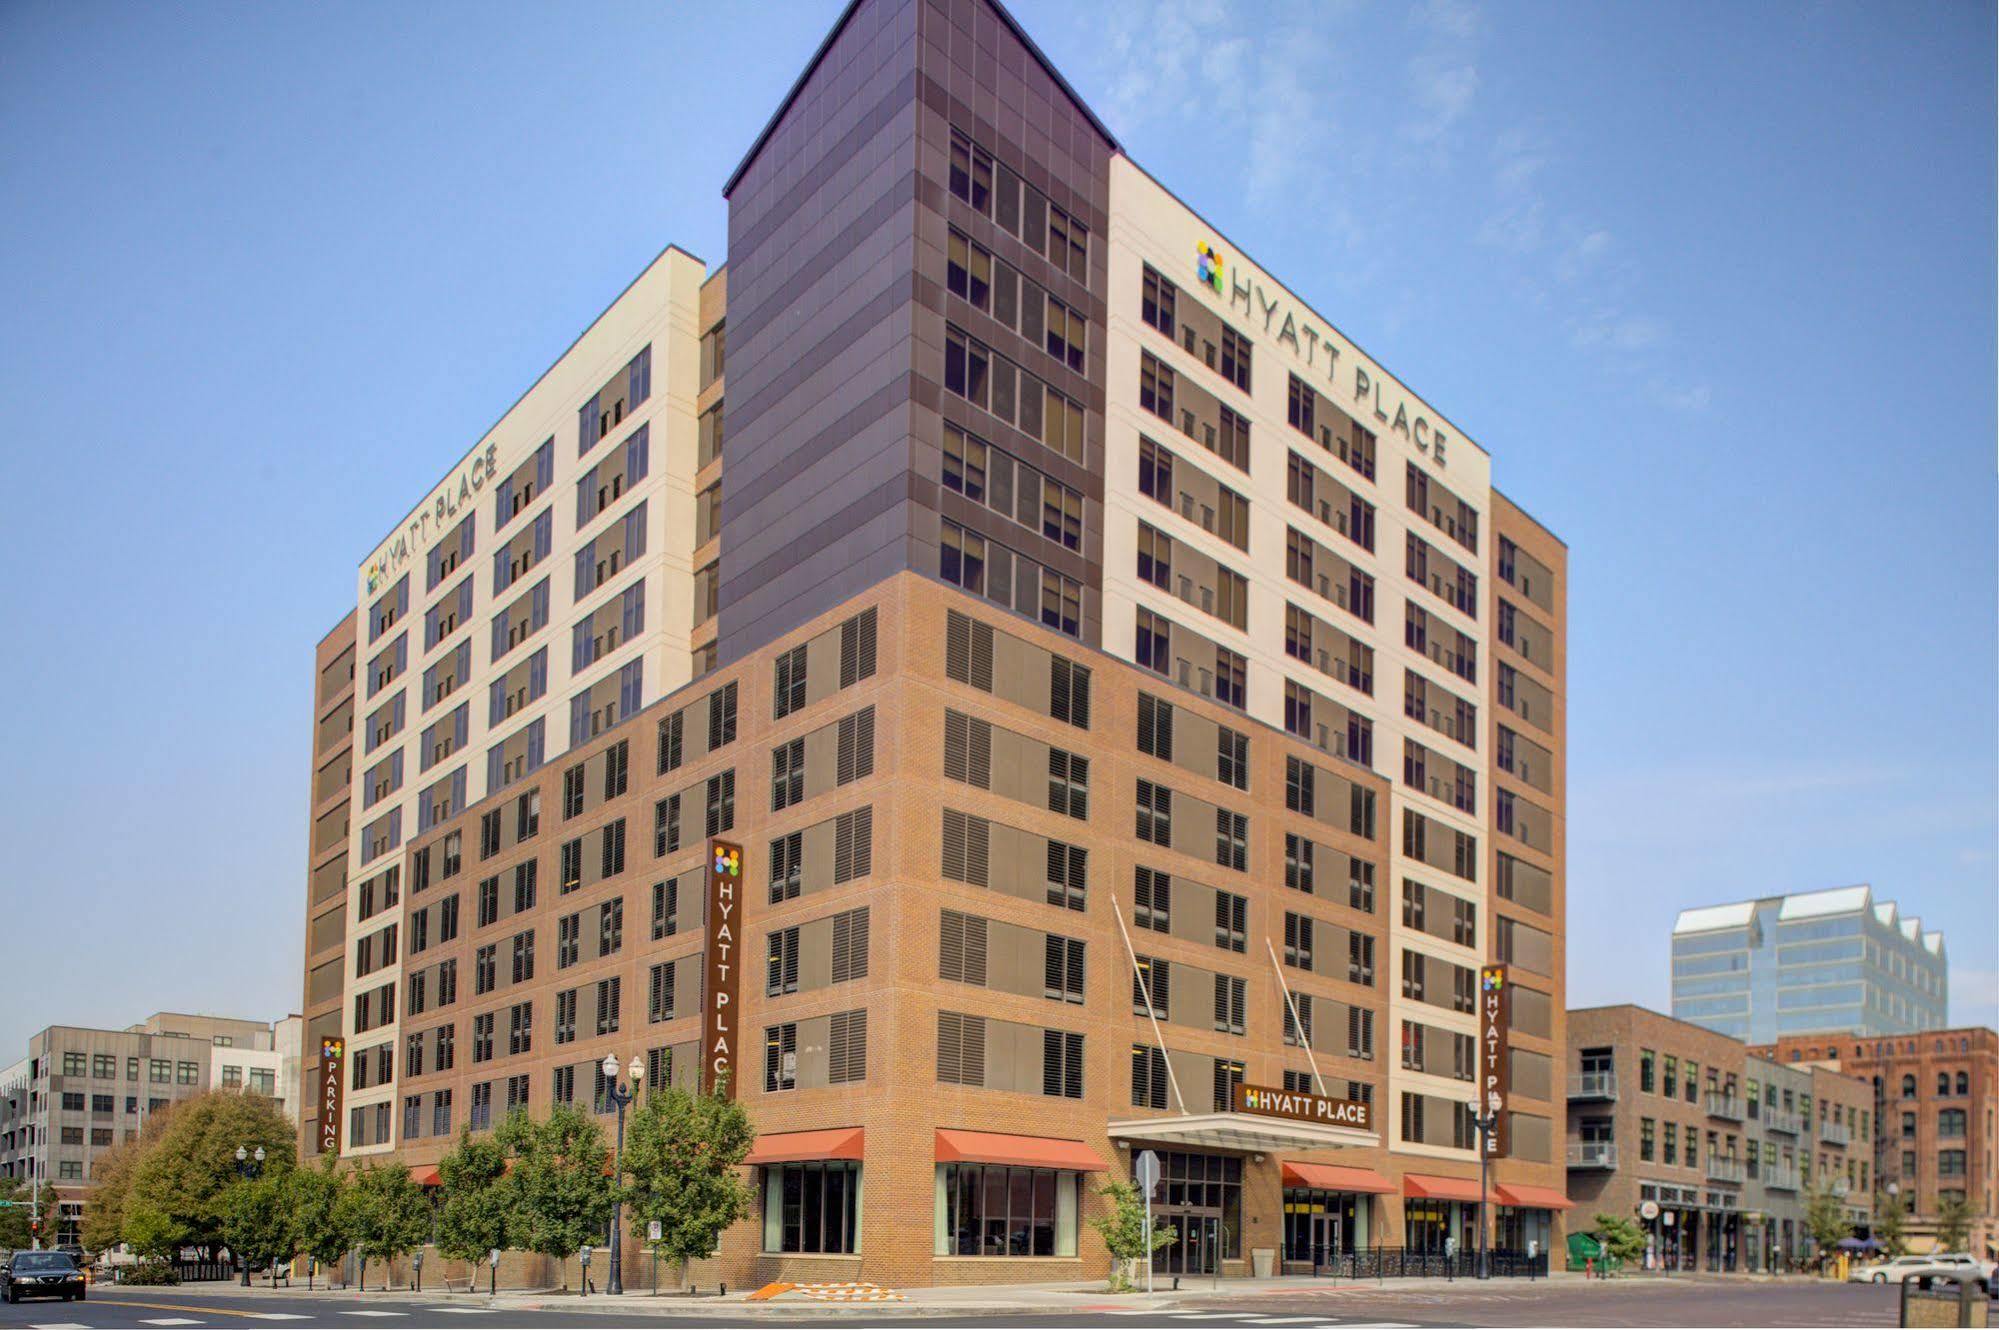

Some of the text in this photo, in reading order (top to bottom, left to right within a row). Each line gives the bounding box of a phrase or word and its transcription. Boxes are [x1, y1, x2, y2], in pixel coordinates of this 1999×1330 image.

[1230, 266, 1447, 468] HYATT PLACE
[378, 443, 498, 583] HYATT PLACE
[717, 881, 733, 982] HYATT
[1486, 995, 1499, 1069] HYATT
[324, 1061, 338, 1148] PARKING
[1260, 1091, 1367, 1124] HYATT PLACE
